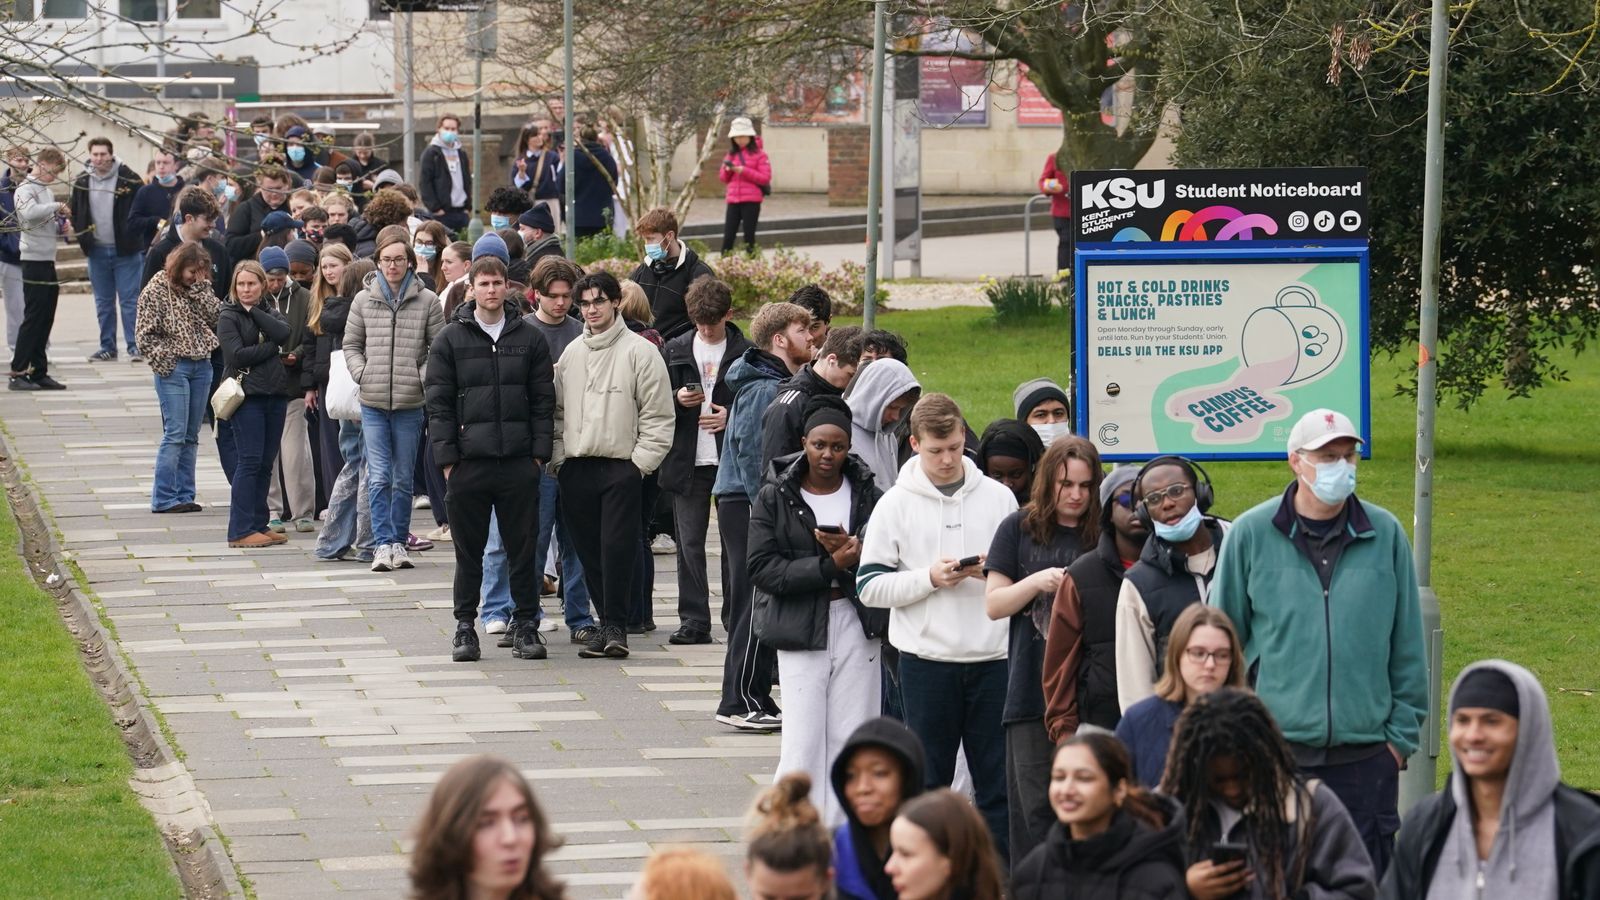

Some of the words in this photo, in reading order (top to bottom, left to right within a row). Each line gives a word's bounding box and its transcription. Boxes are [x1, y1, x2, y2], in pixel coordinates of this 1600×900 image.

[1081, 177, 1165, 209] KSU
[1175, 183, 1246, 198] Student
[1250, 182, 1362, 197] Noticeboard
[1081, 209, 1111, 222] KENT
[1081, 222, 1113, 235] UNION
[1097, 281, 1123, 293] HOT
[1127, 281, 1137, 293] &
[1141, 280, 1176, 292] COLD
[1181, 280, 1230, 292] DRINKS
[1097, 294, 1153, 307] SNACKS,
[1158, 294, 1223, 306] PASTRIES
[1097, 308, 1107, 320] &
[1112, 308, 1156, 320] LUNCH
[1097, 326, 1117, 334] Open
[1118, 326, 1146, 334] Monday
[1147, 325, 1175, 333] through
[1145, 333, 1154, 341] by
[1097, 346, 1132, 357] DEALS
[1135, 346, 1152, 356] VIA
[1155, 346, 1176, 356] THE
[1179, 345, 1199, 356] KSU
[1203, 345, 1223, 355] APP
[1187, 386, 1258, 418] CAMPUS
[1203, 396, 1277, 433] COFFEE
